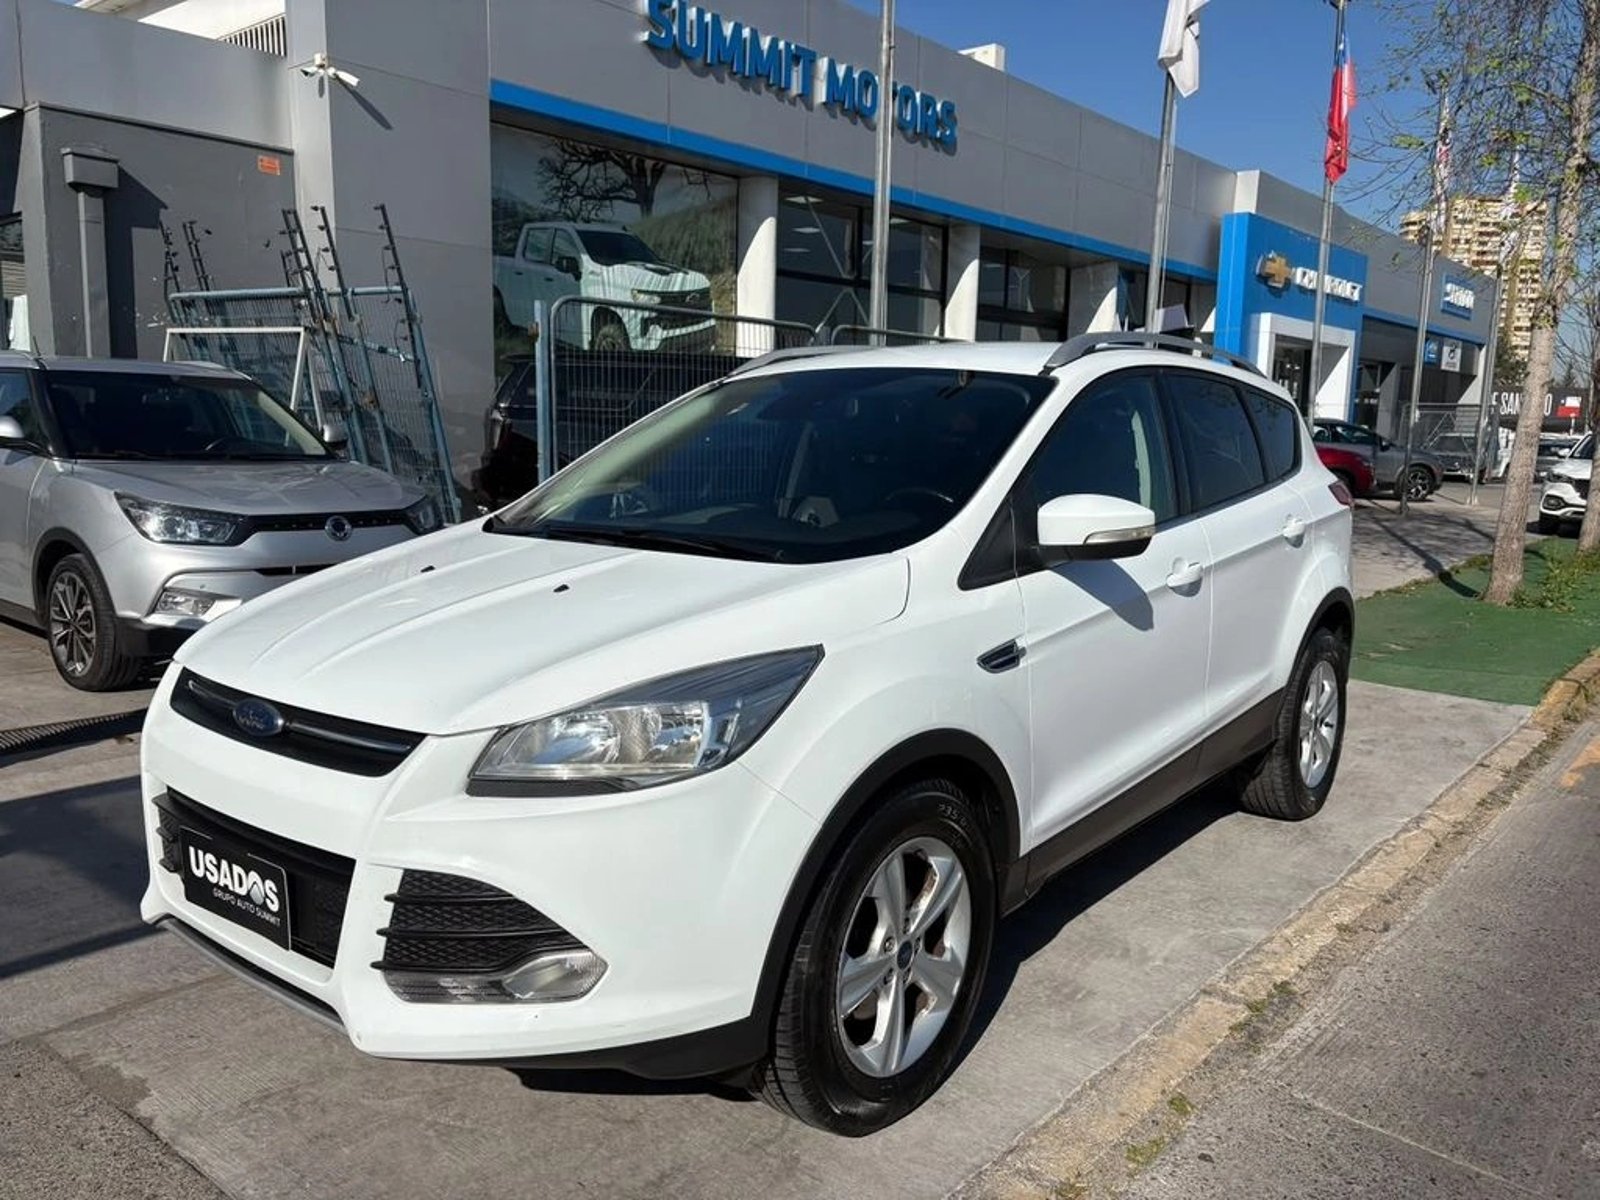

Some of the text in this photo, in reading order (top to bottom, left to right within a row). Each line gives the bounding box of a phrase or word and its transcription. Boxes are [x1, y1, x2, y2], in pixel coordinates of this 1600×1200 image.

[644, 0, 958, 146] SUMMIT MOORS
[188, 845, 280, 912] USADOS
[237, 898, 256, 914] AUTO
